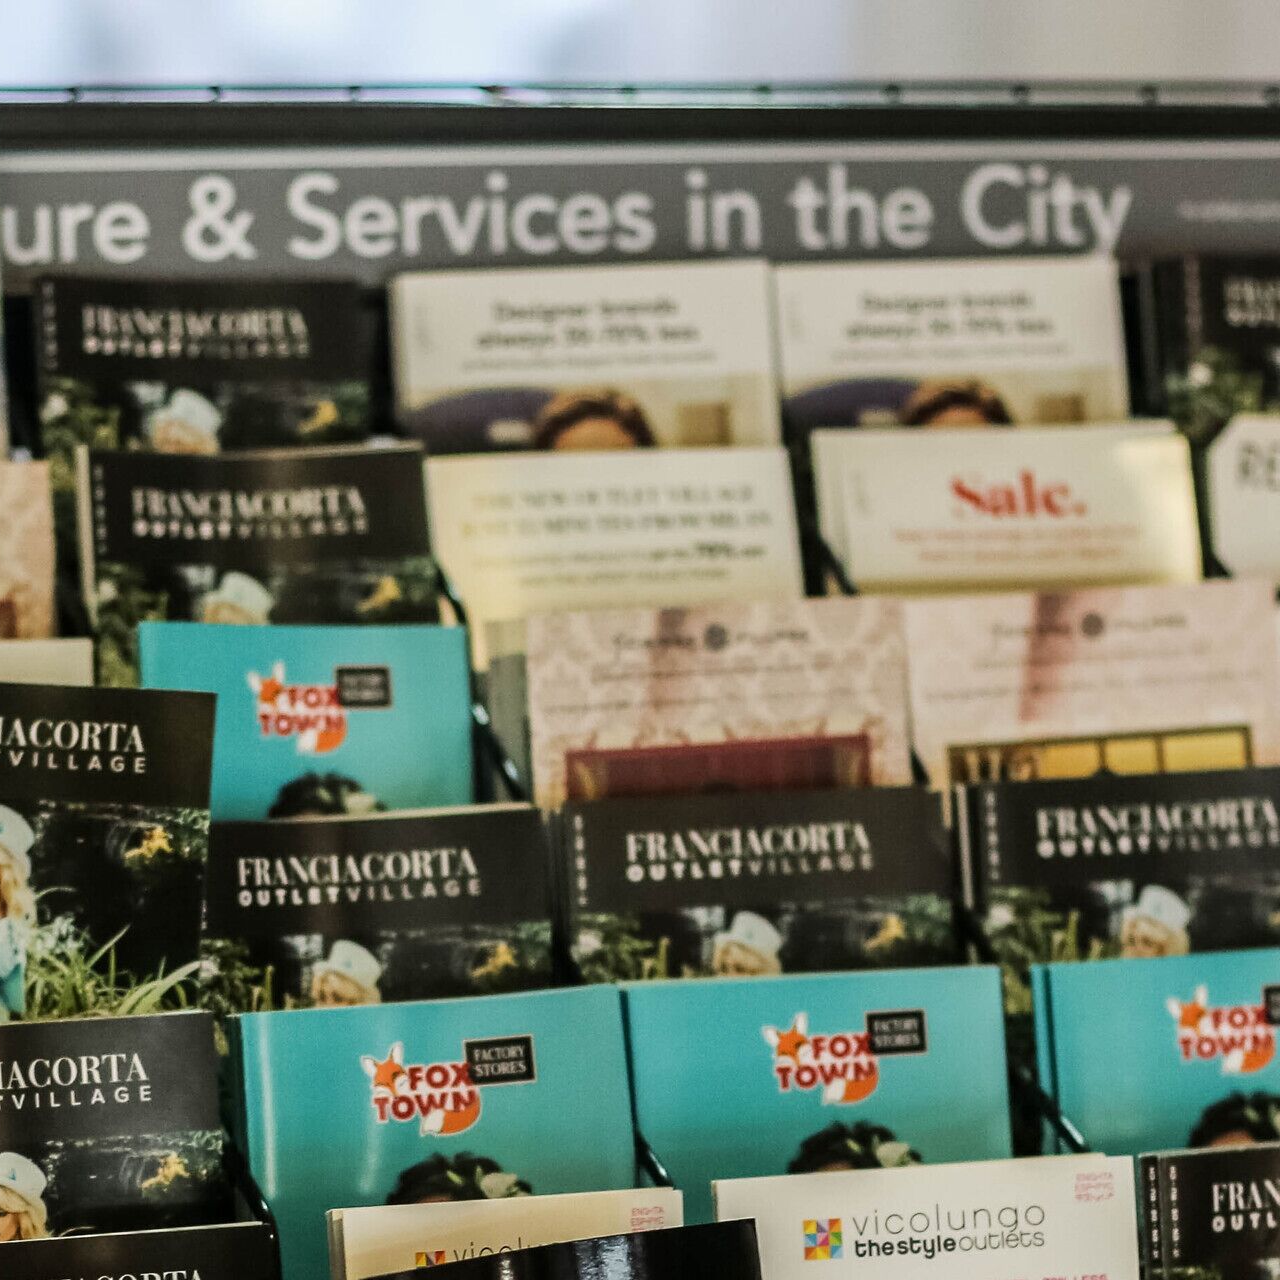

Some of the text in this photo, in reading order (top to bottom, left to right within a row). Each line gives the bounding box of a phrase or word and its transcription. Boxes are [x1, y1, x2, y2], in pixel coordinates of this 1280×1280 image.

[183, 174, 257, 263] &
[287, 171, 657, 258] Services
[685, 168, 761, 251] in
[790, 161, 933, 251] the
[961, 161, 1132, 260] City
[627, 820, 870, 861] FRANCIACORTA
[238, 846, 479, 886] FRANCIACORTA
[1212, 1005, 1269, 1031] FOX
[812, 1032, 873, 1059] FOX
[1178, 1034, 1274, 1060] TOWN
[407, 1062, 472, 1090] FOX
[777, 1060, 876, 1088] TOWN
[375, 1090, 479, 1120] TOWN
[851, 1202, 1046, 1235] vicolungo
